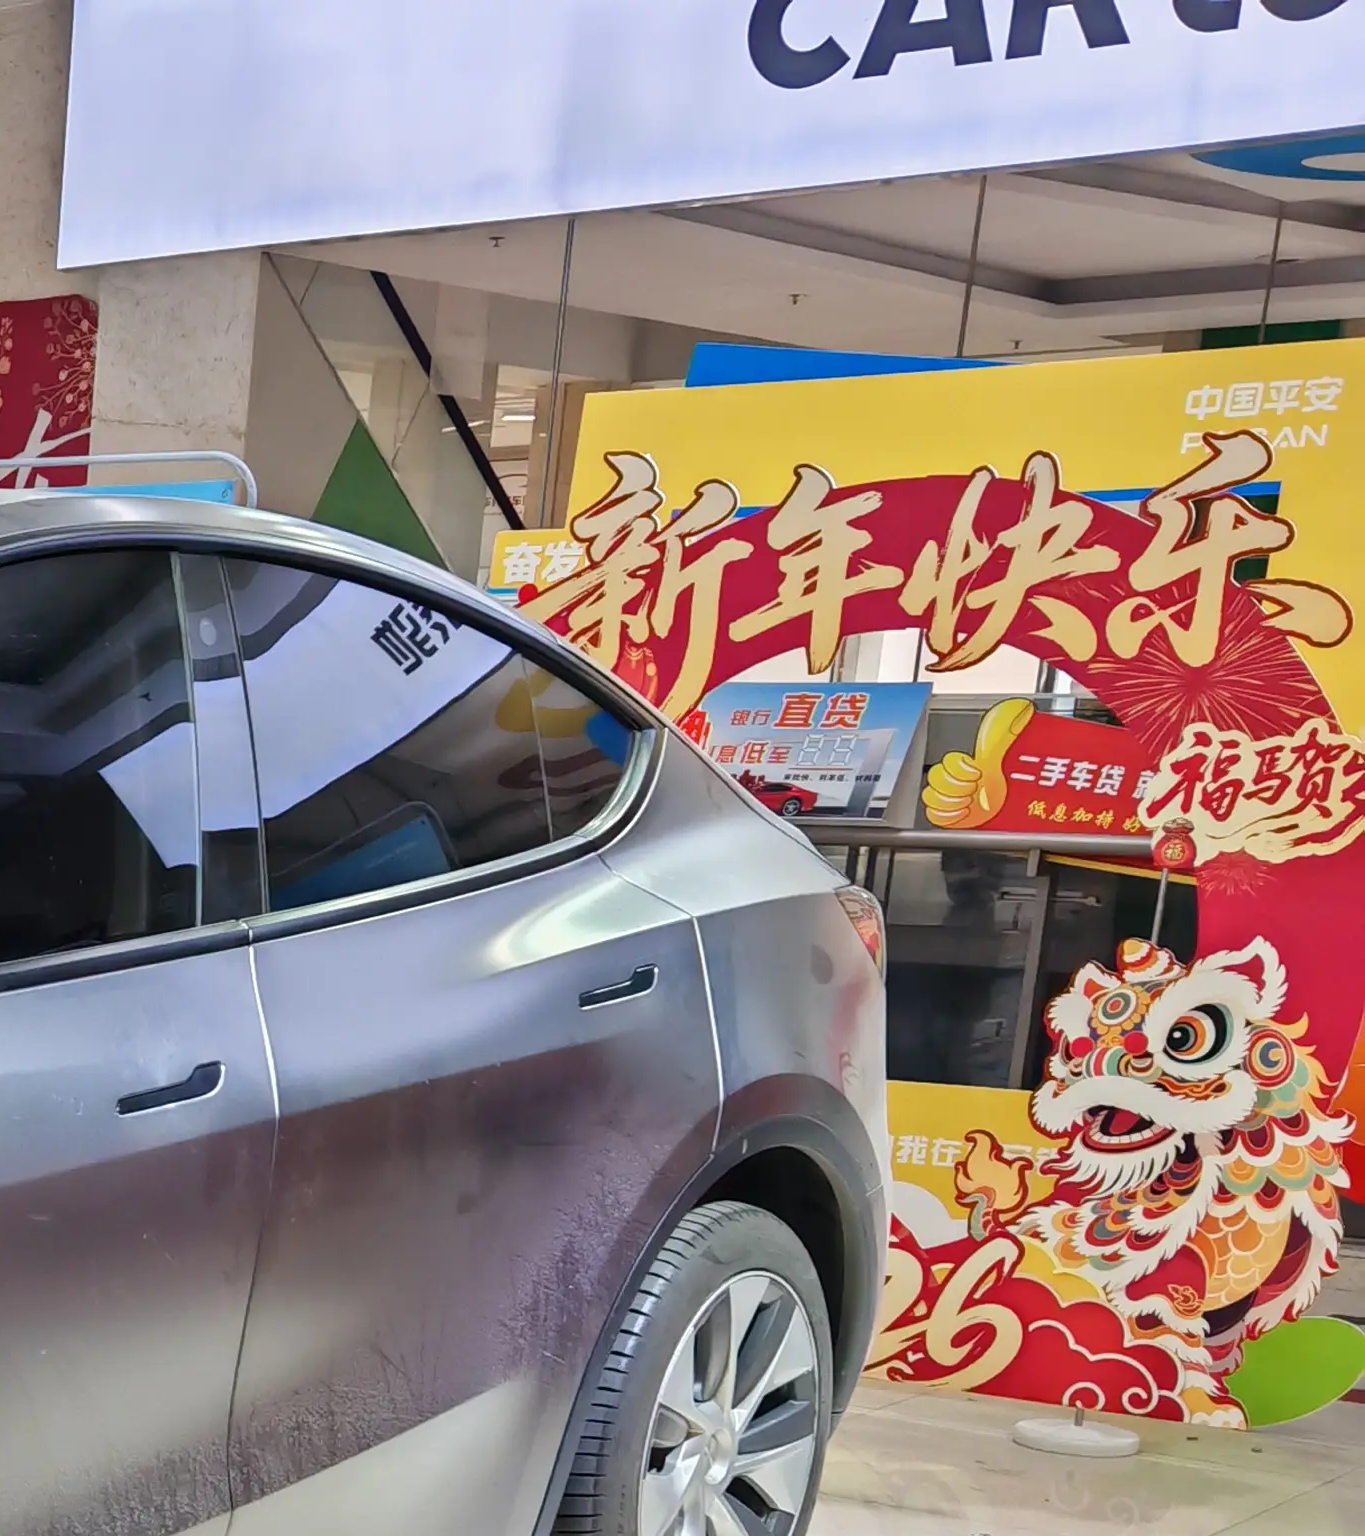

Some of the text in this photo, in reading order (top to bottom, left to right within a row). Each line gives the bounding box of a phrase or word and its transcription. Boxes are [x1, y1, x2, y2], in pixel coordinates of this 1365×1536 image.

[1185, 377, 1344, 421] 中国平安
[503, 542, 584, 584] 奋发
[539, 430, 1355, 718] 新年快乐
[1011, 753, 1126, 796] 二手车贷
[1028, 800, 1115, 829] 低息加持
